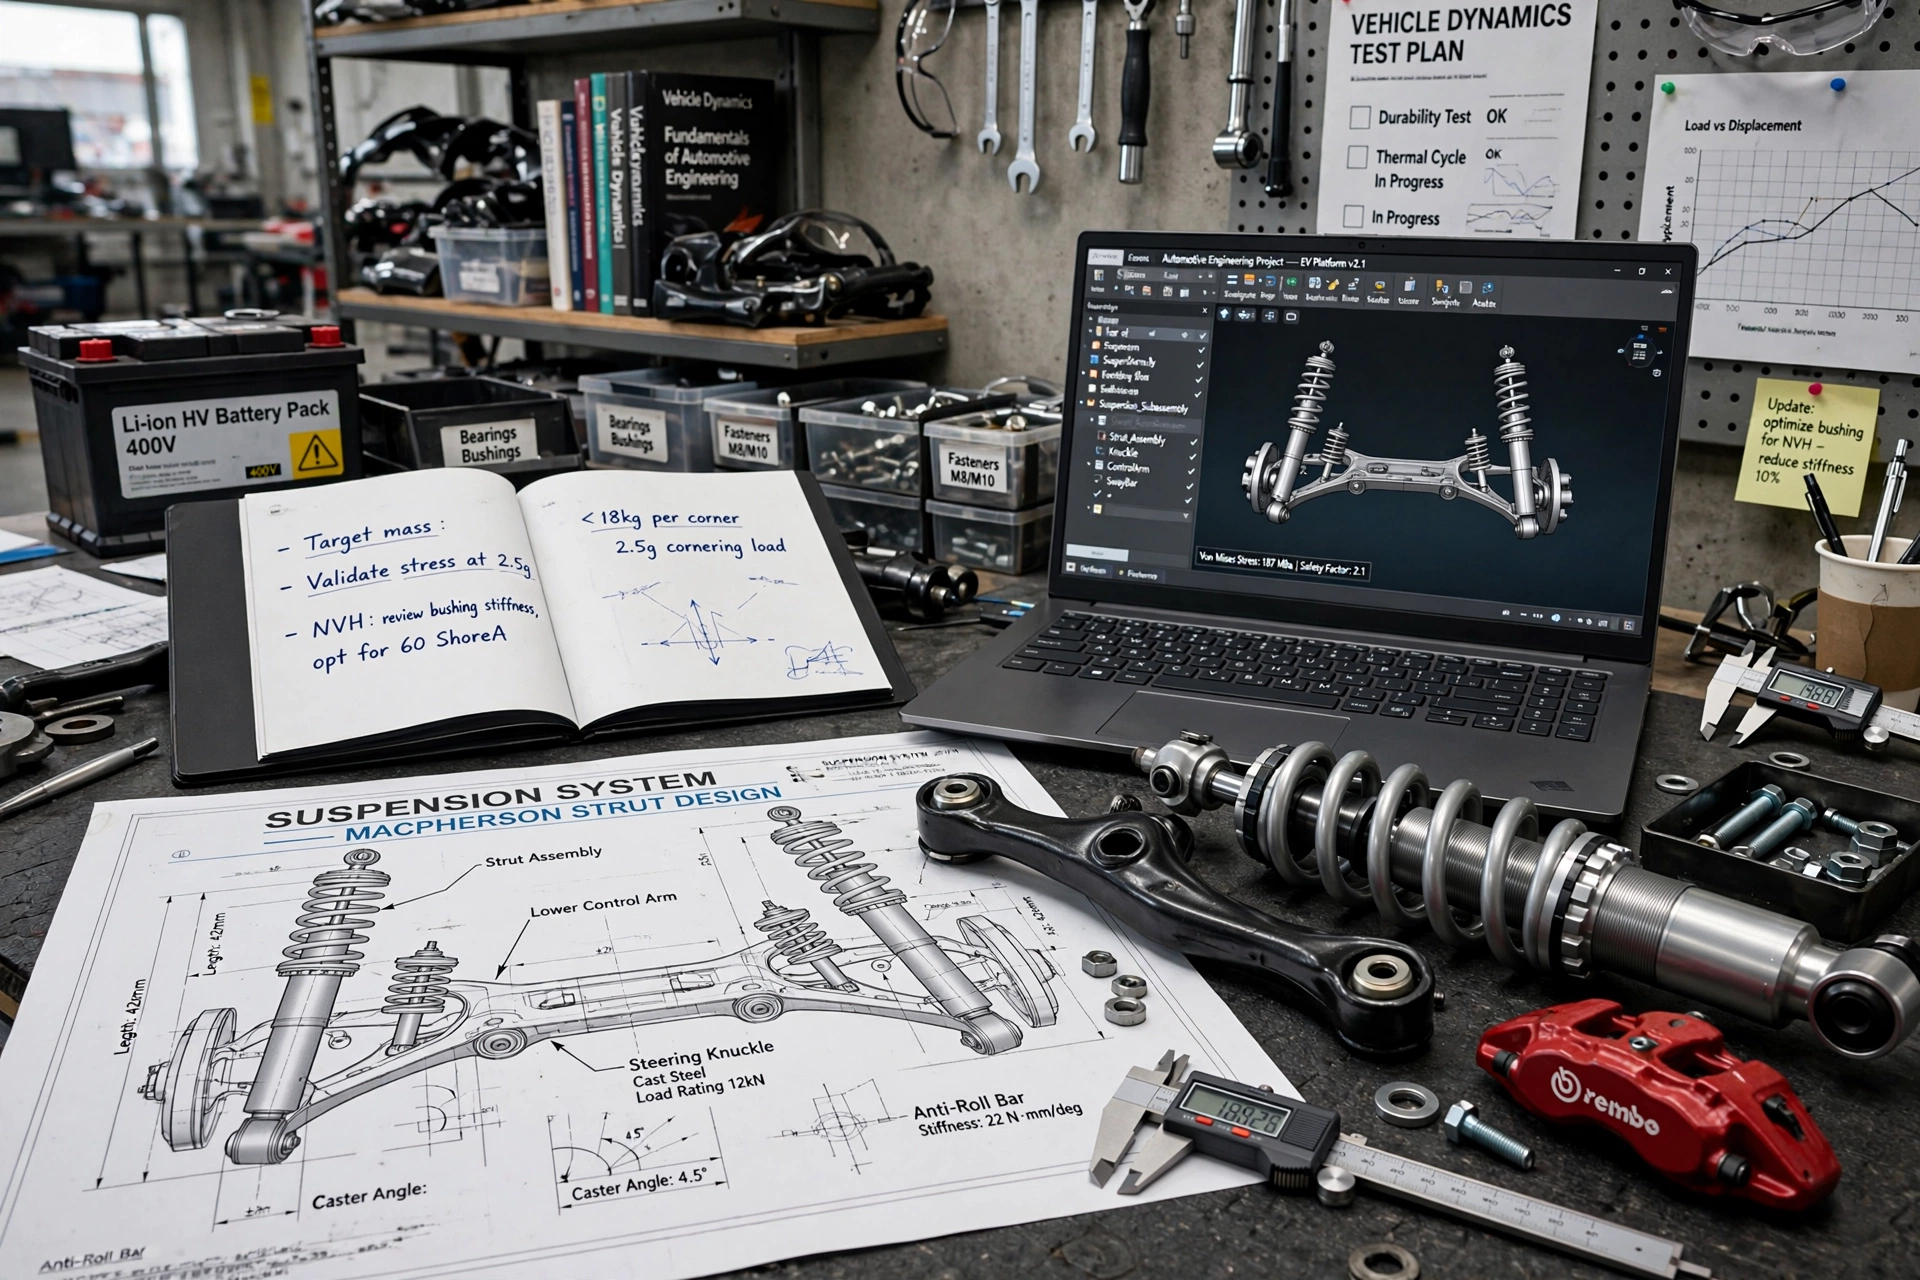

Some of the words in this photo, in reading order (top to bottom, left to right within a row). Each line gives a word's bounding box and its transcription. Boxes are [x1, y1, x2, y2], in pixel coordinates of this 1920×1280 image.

[1351, 10, 1441, 35] VEHICLE
[1447, 2, 1572, 32] DYNAMICS
[1350, 42, 1401, 64] TEST
[1407, 39, 1464, 63] PLAN
[662, 89, 701, 106] Vehicle
[703, 91, 753, 111] Dynamics
[1379, 109, 1441, 127] Durability
[1445, 109, 1472, 124] Test
[1487, 108, 1507, 124] OK
[1685, 119, 1711, 132] Load
[1713, 121, 1726, 132] vs
[1728, 119, 1802, 134] Displacement
[664, 126, 750, 146] Fundamentals
[665, 147, 679, 164] of
[681, 148, 751, 166] Automotive
[1376, 149, 1428, 164] Thermal
[1431, 149, 1467, 167] Cycle
[1485, 148, 1502, 160] OK
[665, 168, 739, 190] Engineering
[1375, 173, 1387, 188] In
[1390, 173, 1444, 192] Progress
[1372, 210, 1383, 224] In
[1386, 210, 1440, 228] Progress
[1162, 254, 1207, 265] Automotive
[1208, 255, 1254, 268] Engineering
[1256, 257, 1284, 268] Project
[1301, 257, 1312, 267] EV
[1313, 257, 1347, 268] Platform
[1348, 259, 1366, 269] v2.1
[122, 414, 177, 433] Li-ion
[182, 409, 209, 428] HV
[216, 406, 282, 425] Battery
[287, 399, 330, 418] Pack
[1767, 397, 1815, 414] Update:
[460, 427, 517, 444] Bearings
[609, 414, 651, 435] Bearings
[724, 425, 771, 443] Fasteners
[1763, 417, 1814, 432] optimize
[1818, 421, 1864, 442] bushing
[126, 436, 177, 456] 400V
[611, 432, 654, 452] Bushings
[728, 443, 768, 460] M8/M10
[1761, 432, 1779, 446] for
[1783, 436, 1812, 450] NVH
[462, 446, 521, 463] Bushings
[949, 452, 999, 470] Fasteners
[1758, 453, 1799, 468] reduce
[1802, 458, 1855, 475] stiffness
[951, 470, 995, 487] M8/M10
[1756, 470, 1780, 484] 10%
[652, 513, 679, 529] per
[688, 513, 740, 524] corner
[304, 527, 373, 554] Target
[615, 540, 657, 560] 2.5g
[667, 540, 743, 559] cornering
[751, 538, 787, 553] load
[307, 564, 390, 590] Validate
[400, 556, 456, 575] stress
[467, 552, 488, 567] at
[498, 553, 531, 579] 2.5g
[1262, 557, 1276, 567] 187
[1300, 561, 1324, 575] Safety
[1353, 566, 1366, 576] 2.1
[382, 608, 424, 625] review
[430, 599, 478, 618] bushing
[484, 597, 539, 619] stiffness,
[313, 648, 347, 674] opt
[358, 643, 389, 663] for
[400, 637, 426, 653] 60
[265, 786, 542, 829] SUSPENSION
[556, 771, 717, 800] SYSTEM
[345, 807, 562, 842] MACPHERSON
[571, 797, 667, 818] STRUT
[675, 786, 782, 808] DESIGN
[485, 853, 524, 868] Strut
[528, 845, 602, 864] Assembly
[530, 901, 578, 918] Lower
[583, 897, 641, 912] Control
[645, 892, 677, 905] Arm
[629, 1054, 702, 1072] Steering
[707, 1041, 775, 1061] Knuckle
[633, 1074, 666, 1088] Cast
[670, 1066, 707, 1083] Steel
[636, 1087, 673, 1103] Load
[677, 1081, 725, 1099] Rating
[728, 1074, 766, 1090] 12kN
[914, 1096, 991, 1120] Anti-Roll
[994, 1092, 1024, 1108] Bar
[918, 1117, 983, 1137] Stiffness:
[987, 1113, 1005, 1128] 22
[572, 1182, 621, 1202] Caster
[626, 1174, 674, 1194] Angle:
[678, 1167, 708, 1184] 4.5°
[312, 1190, 366, 1211] Caster
[373, 1182, 427, 1202] Angle:
[39, 1250, 113, 1272] Anti-Roll
